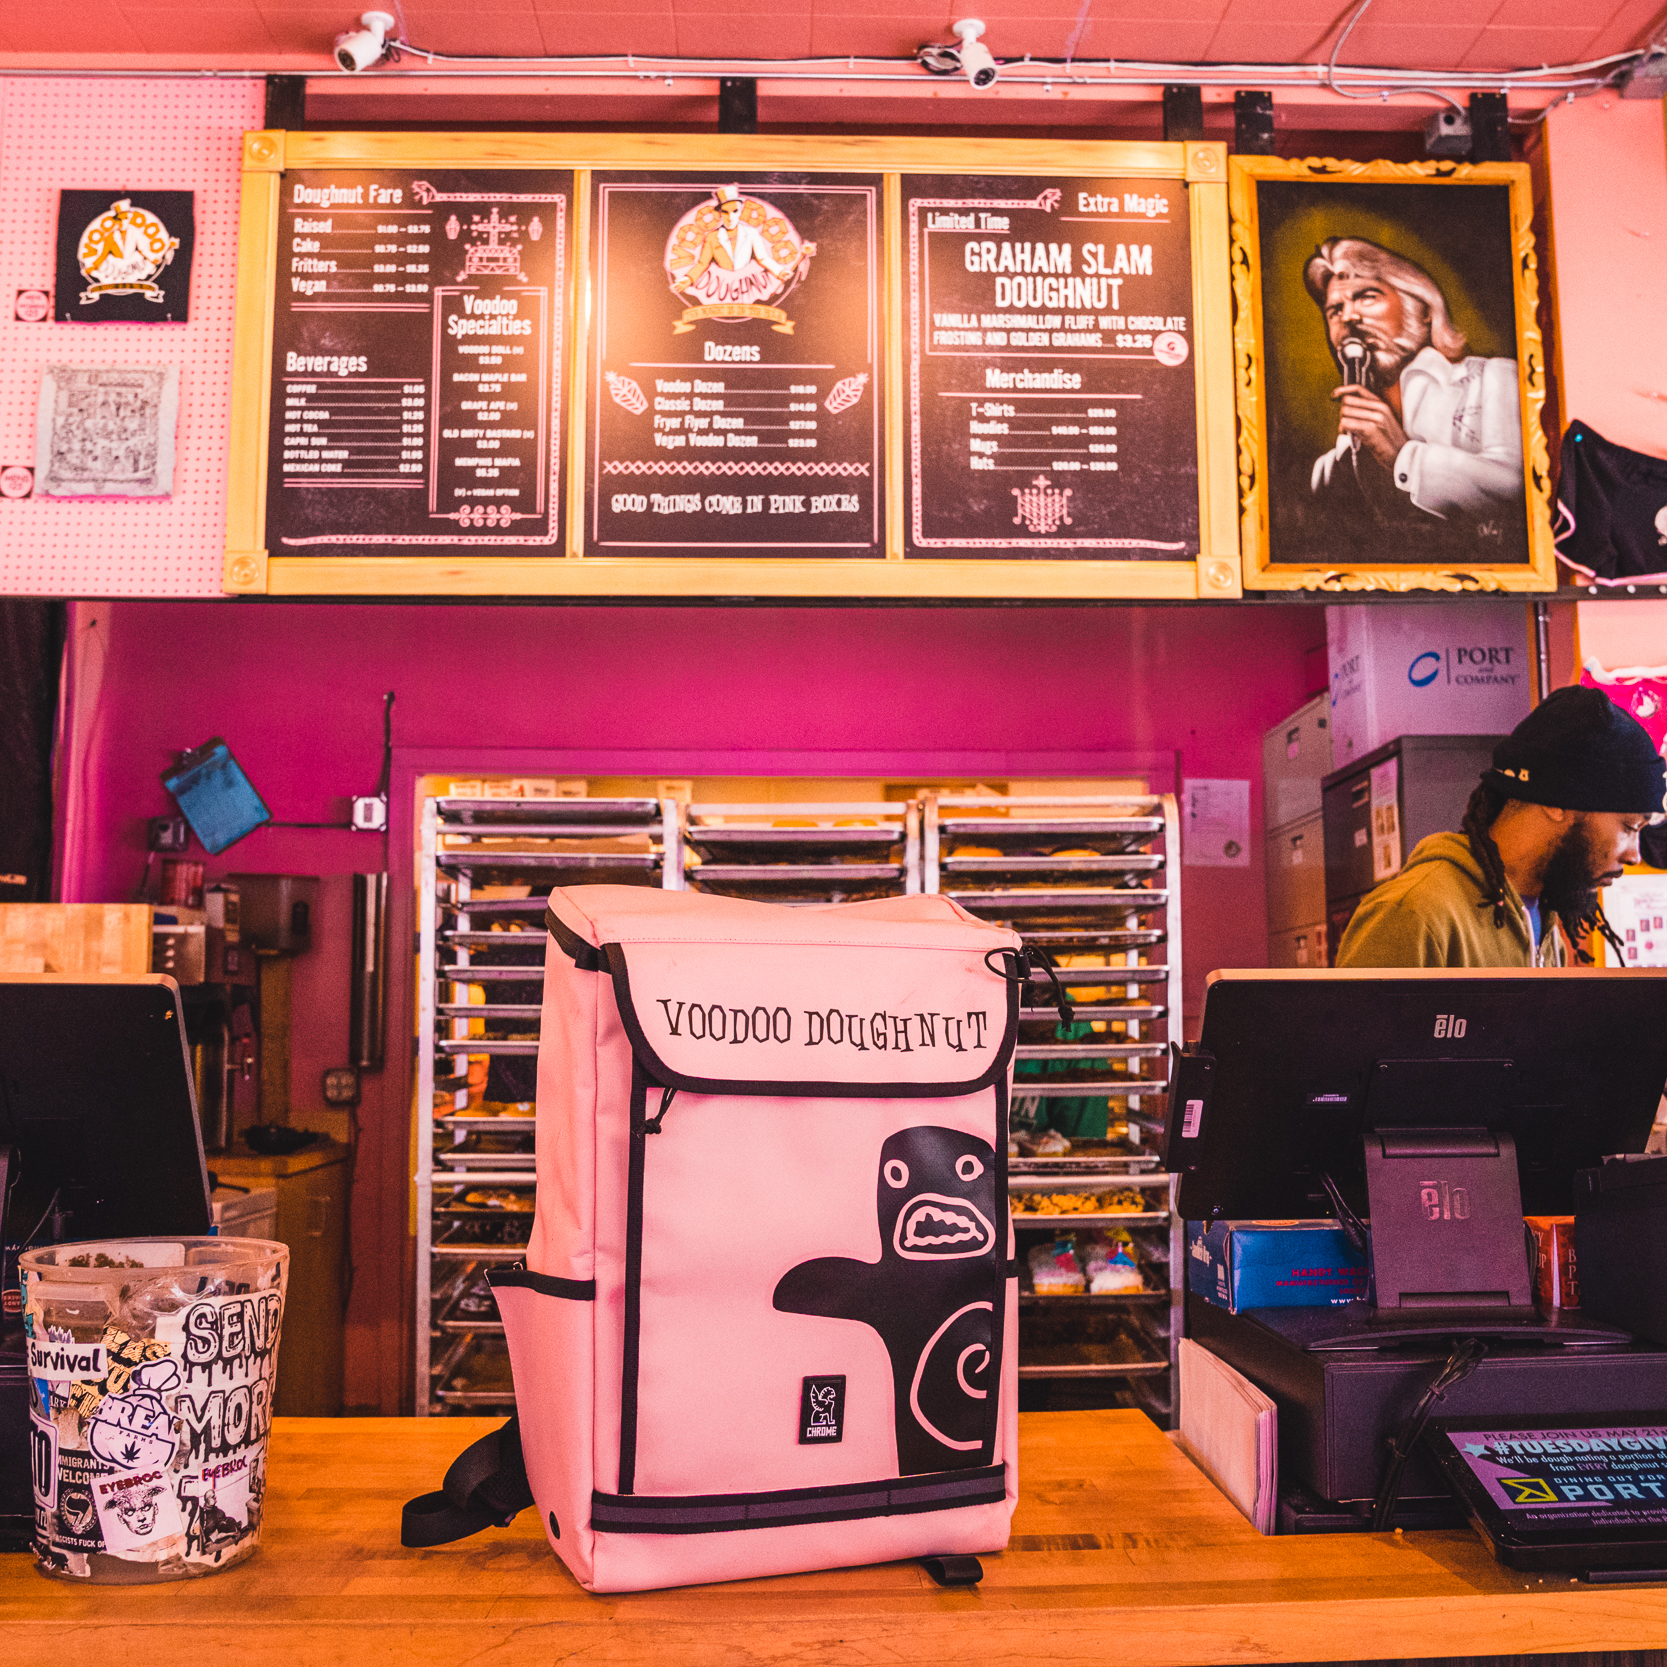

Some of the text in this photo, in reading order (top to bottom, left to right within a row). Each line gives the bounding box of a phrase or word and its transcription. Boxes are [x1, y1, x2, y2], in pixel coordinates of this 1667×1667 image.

[293, 184, 403, 208] Doughnut Fare
[1078, 192, 1169, 218] Extra Magic
[293, 217, 333, 234] Raised
[927, 212, 1011, 230] Limited Time
[292, 237, 320, 253] Cake
[291, 257, 338, 273] Fritters
[964, 241, 1153, 276] GRAHAM SLAM
[291, 276, 327, 296] Vegan
[995, 275, 1124, 311] DOUGHNUT
[463, 294, 518, 315] Voodoo
[447, 314, 532, 340] Specialties
[933, 312, 1187, 332] VANILLA MARSHMALLOW FLUFF WITH CHOCOLATE
[933, 331, 1153, 349] FROSTING AND GOLDEN GRAHAMS $3.25
[704, 340, 761, 362] Dozens
[285, 351, 368, 377] Beverages
[655, 379, 692, 394] Voodoo
[693, 379, 725, 394] Dozen
[985, 368, 1082, 390] Merchandise
[286, 384, 317, 394] COFFEE
[654, 397, 691, 411] Classic
[693, 398, 724, 411] Dozen
[970, 402, 1016, 417] T-Shirts
[302, 423, 319, 433] TEA
[654, 415, 682, 432] Fryer
[684, 415, 711, 432] Flyer
[712, 415, 744, 429] Dozen
[969, 421, 1010, 435] Hoodies
[654, 433, 686, 450] Vegan
[688, 433, 725, 447] Voodoo
[726, 433, 758, 447] Dozen
[969, 438, 999, 455] Mugs
[969, 456, 995, 472] Hats
[611, 493, 860, 514] GOOD THINGS COME IN PINK BOXES
[1457, 647, 1514, 665] PORT
[1455, 674, 1516, 685] COMPANY
[656, 998, 988, 1053] VOODOO DOUGHNUT
[1292, 1267, 1333, 1277] HANDY
[182, 1294, 282, 1362] SEND
[30, 1341, 102, 1373] Survival
[119, 1430, 154, 1445] FARMS
[806, 1426, 837, 1438] CHROME
[1483, 1432, 1538, 1441] PLEASE
[1540, 1431, 1578, 1440] JOIN
[1579, 1430, 1602, 1438] US
[1606, 1429, 1638, 1437] MAY
[1492, 1436, 1667, 1455] #TUESDAYGIV
[1525, 1455, 1539, 1464] be
[1618, 1452, 1655, 1462] portion
[1549, 1463, 1577, 1472] from
[1576, 1462, 1609, 1471] EVERY
[1610, 1461, 1660, 1471] doughnut
[99, 1470, 163, 1495] EYEBROC
[1553, 1476, 1603, 1484] DINING
[1539, 1510, 1590, 1520] organization
[1591, 1509, 1630, 1517] dedicated
[78, 1538, 96, 1548] FUCK
